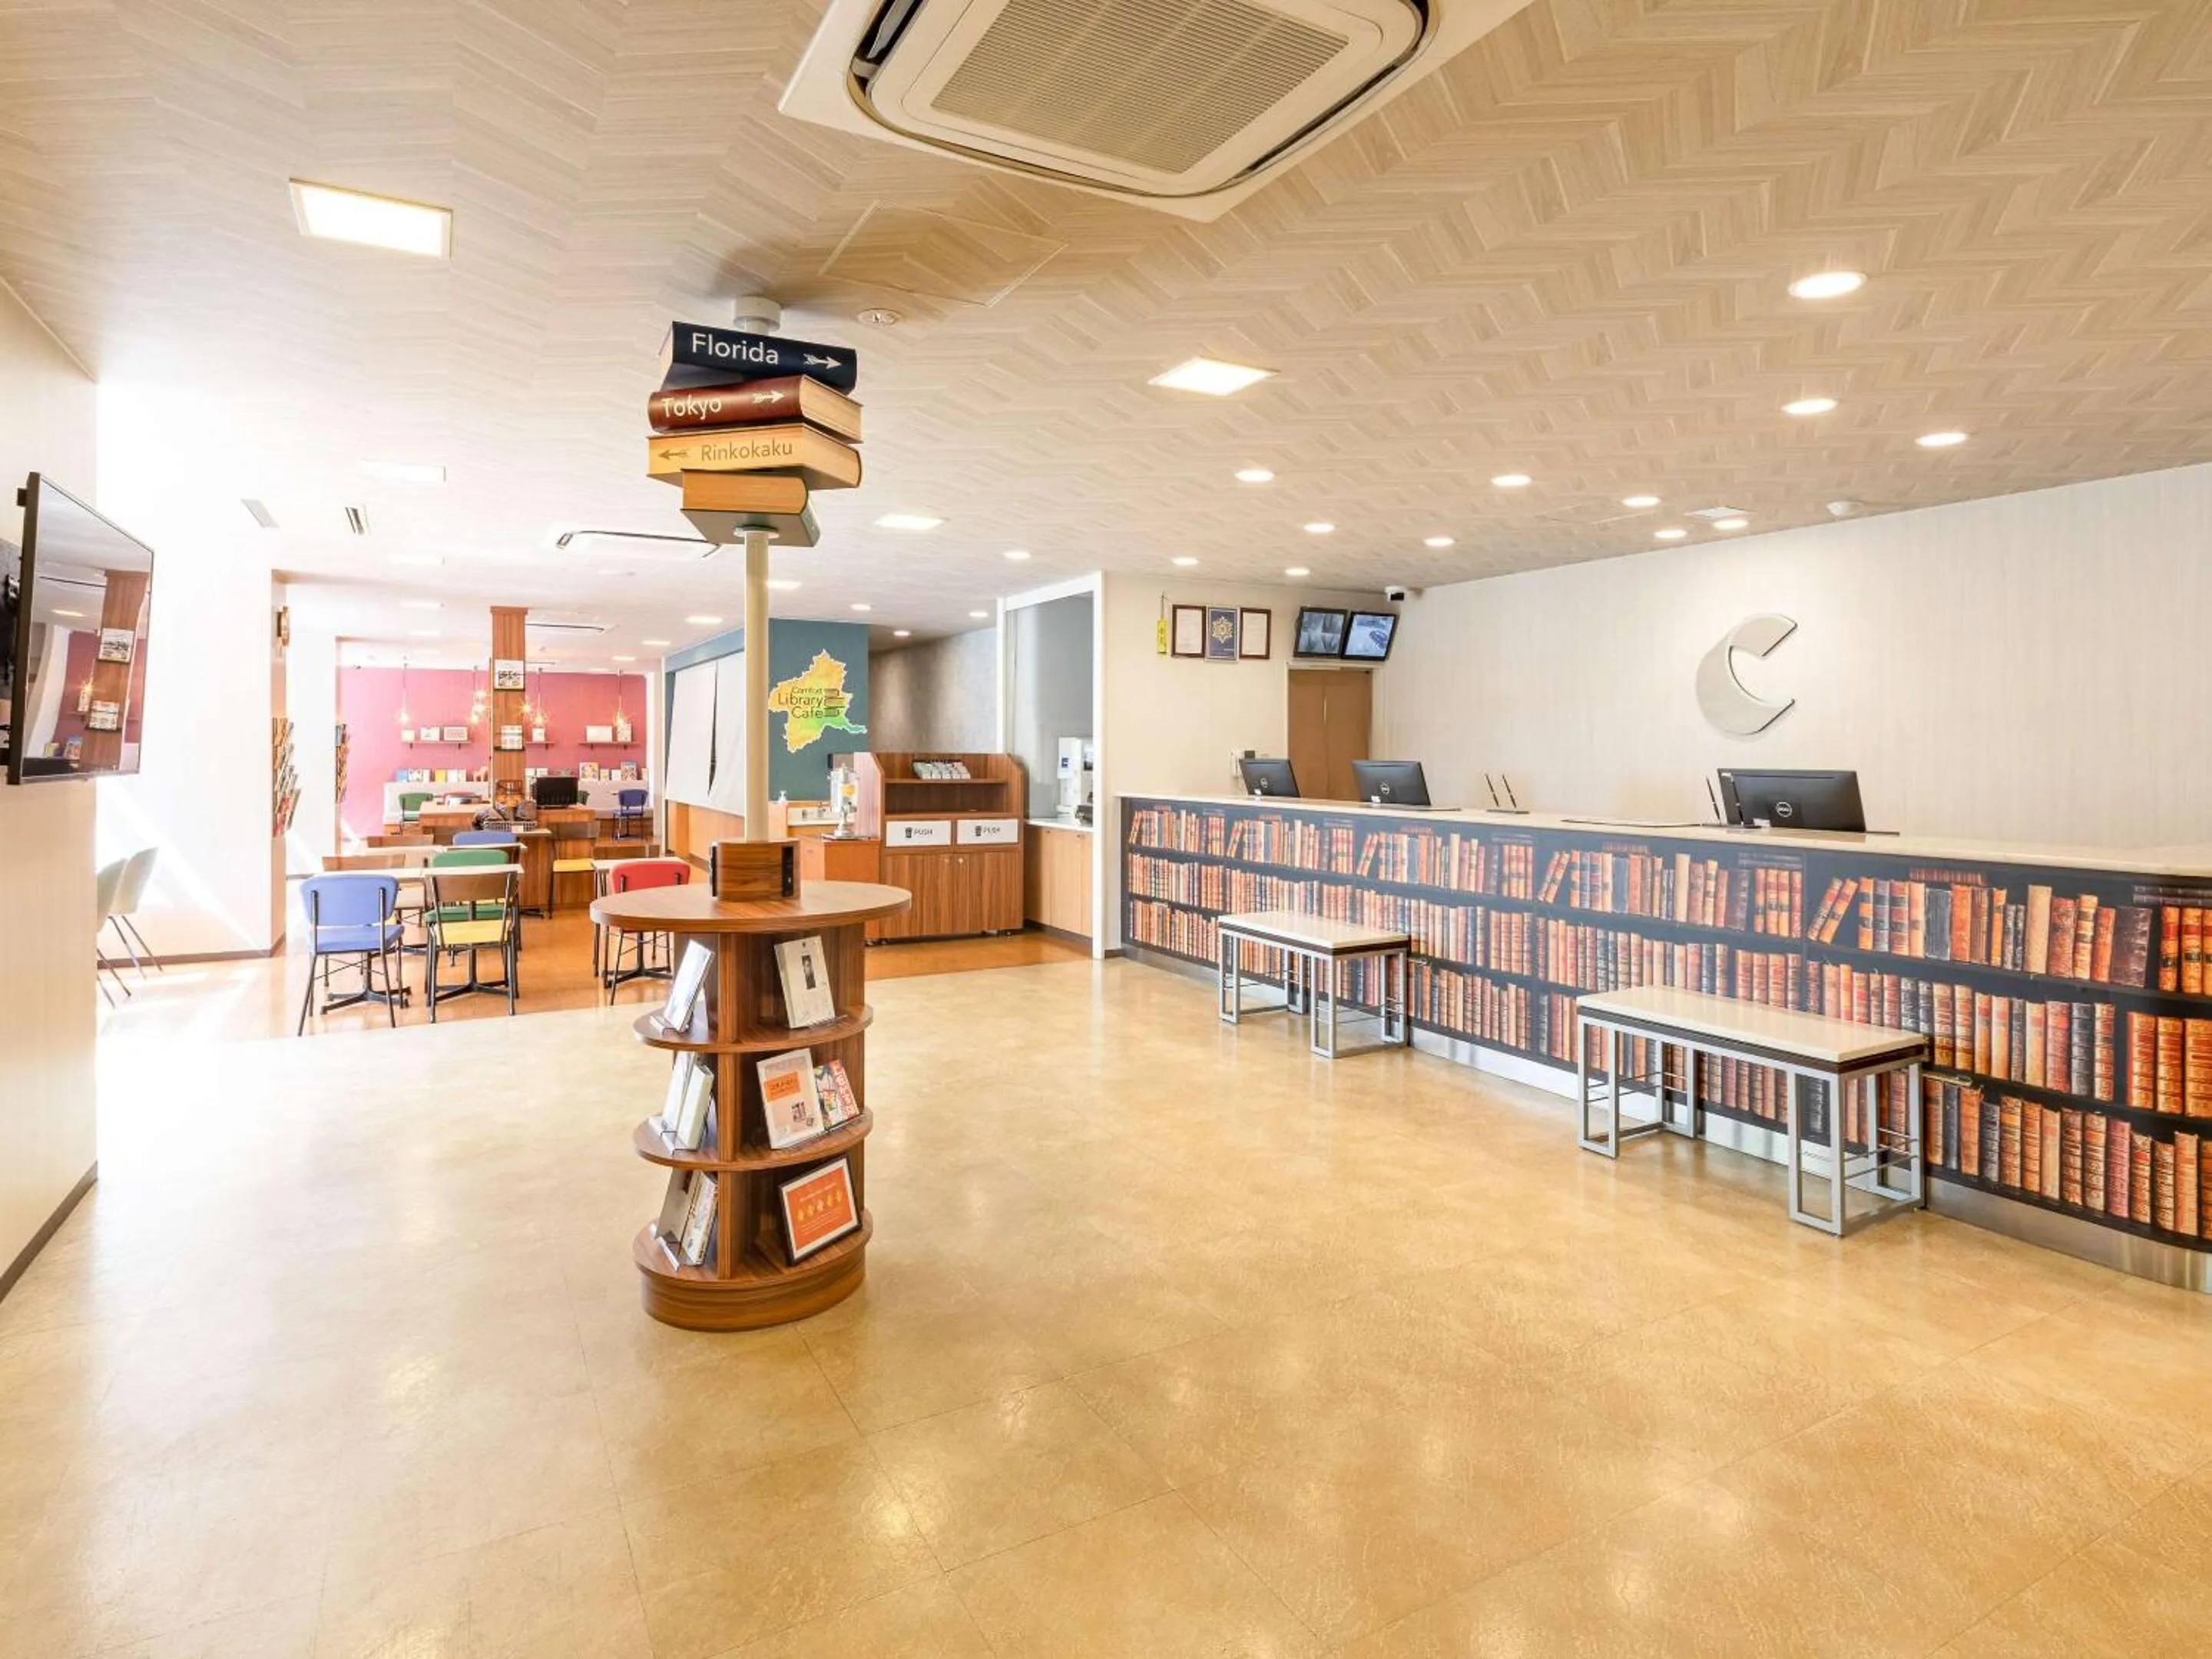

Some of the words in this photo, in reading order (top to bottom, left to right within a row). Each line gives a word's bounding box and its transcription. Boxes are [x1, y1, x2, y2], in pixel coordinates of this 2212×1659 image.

[691, 333, 779, 366] Florida
[661, 394, 722, 420] Tokyo
[700, 439, 793, 462] Rinkokaku
[778, 693, 823, 707] Library
